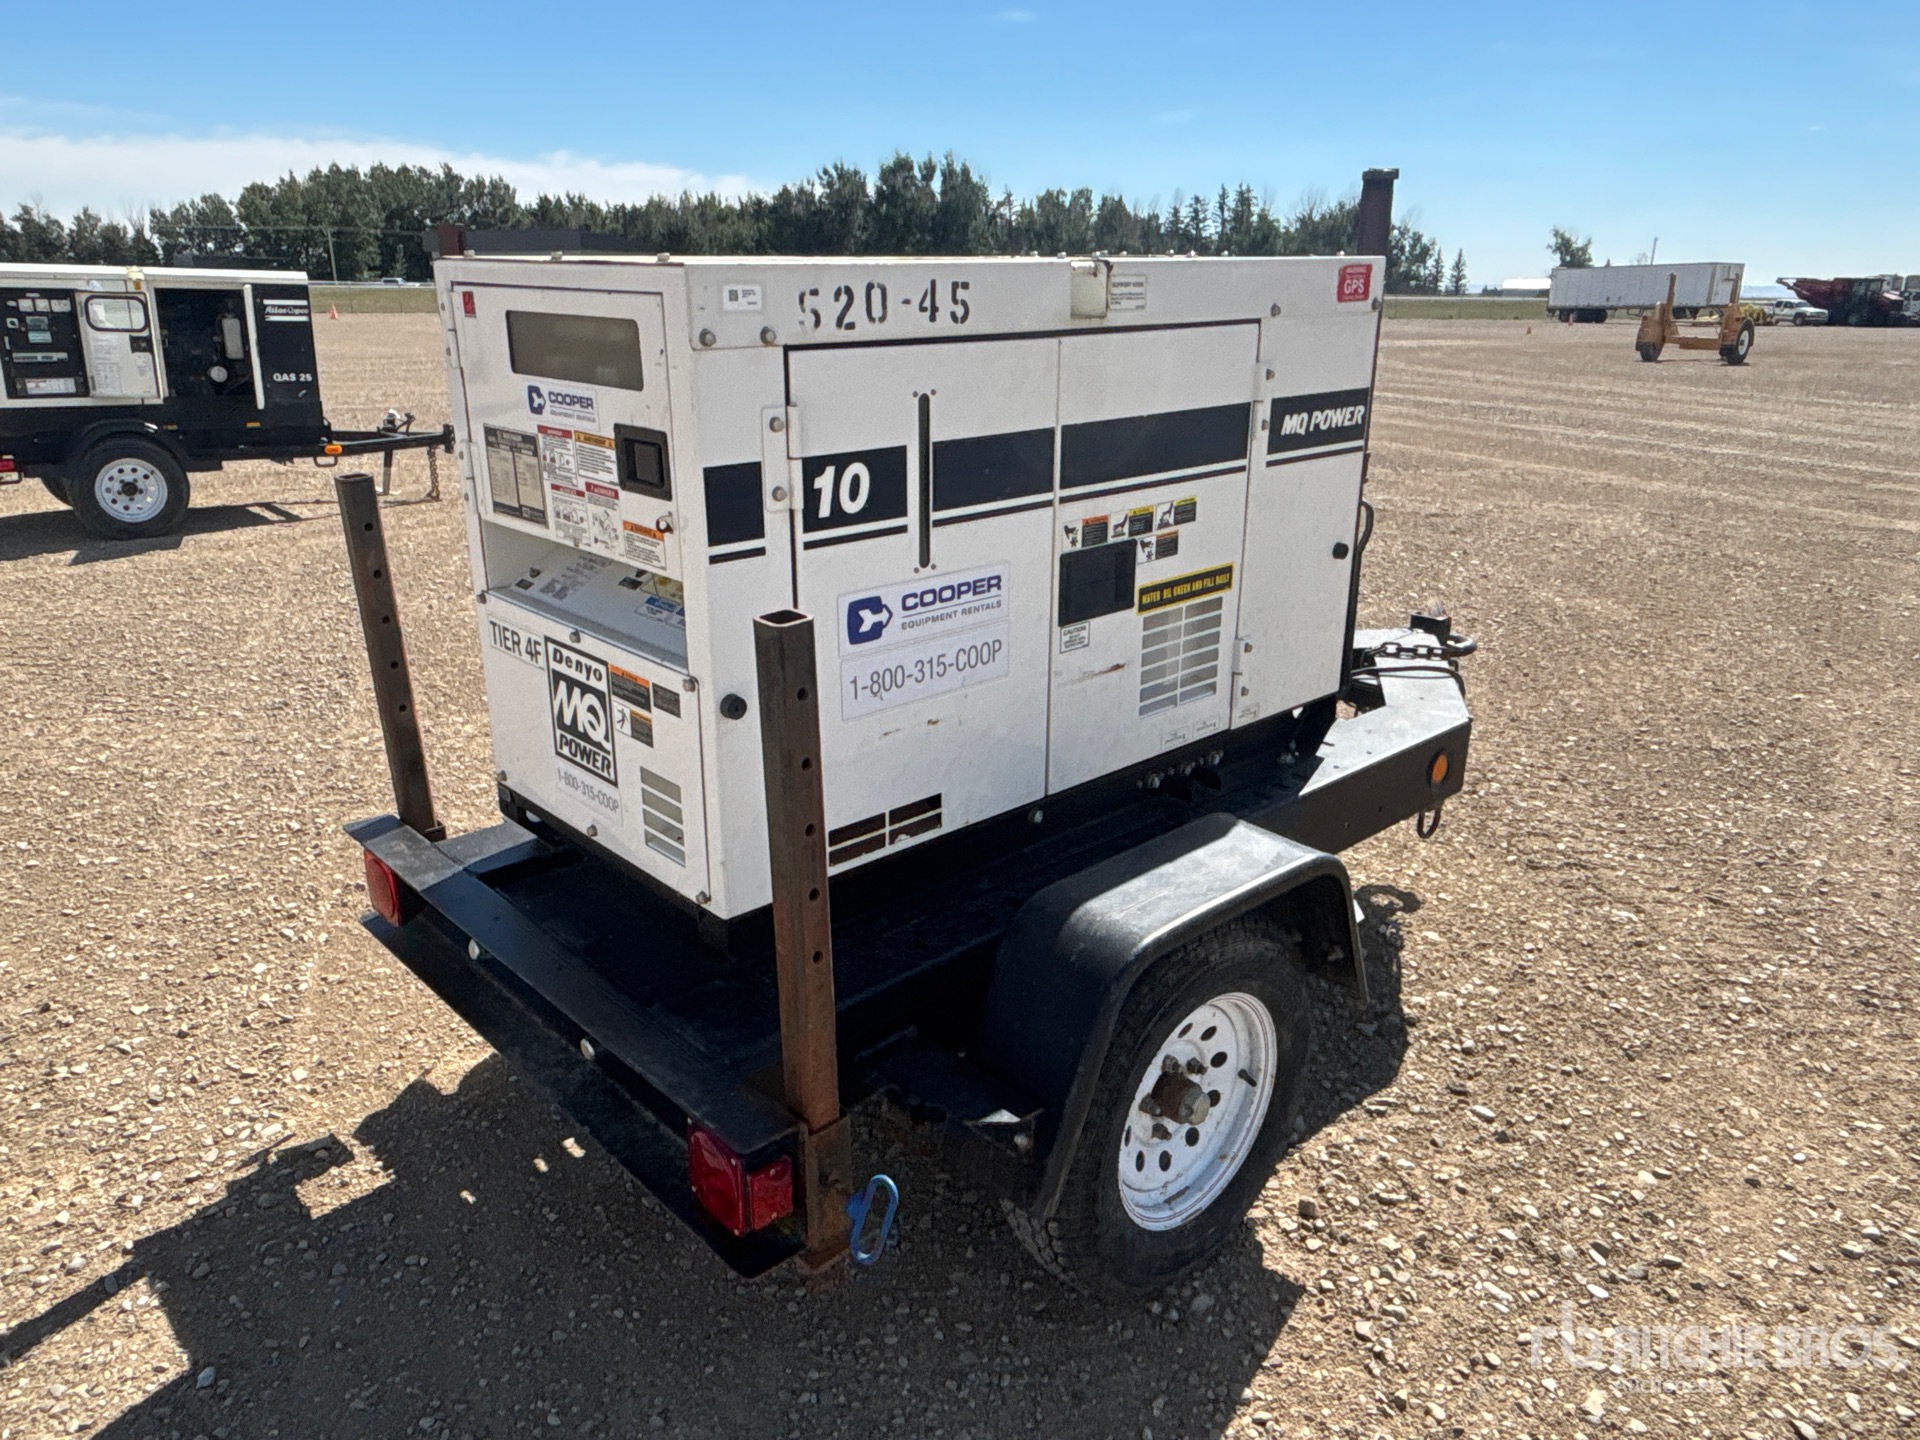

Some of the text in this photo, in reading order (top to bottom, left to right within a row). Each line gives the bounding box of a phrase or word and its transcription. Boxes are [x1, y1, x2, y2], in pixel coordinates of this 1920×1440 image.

[1343, 279, 1365, 295] GPS
[272, 372, 313, 382] QAS 25
[548, 391, 594, 410] COOPER
[1280, 404, 1366, 437] MQ POWER
[813, 462, 871, 519] 10
[901, 575, 1003, 612] COOPER
[901, 599, 1003, 631] EQUIPMENT RENTALS
[490, 620, 544, 666] TIER 4F
[552, 647, 604, 683] Denyo
[849, 638, 1004, 701] 1-800-315-COOP
[554, 679, 612, 754] MQ
[559, 733, 612, 777] POWER
[557, 768, 621, 814] 1-800-315-COOP
